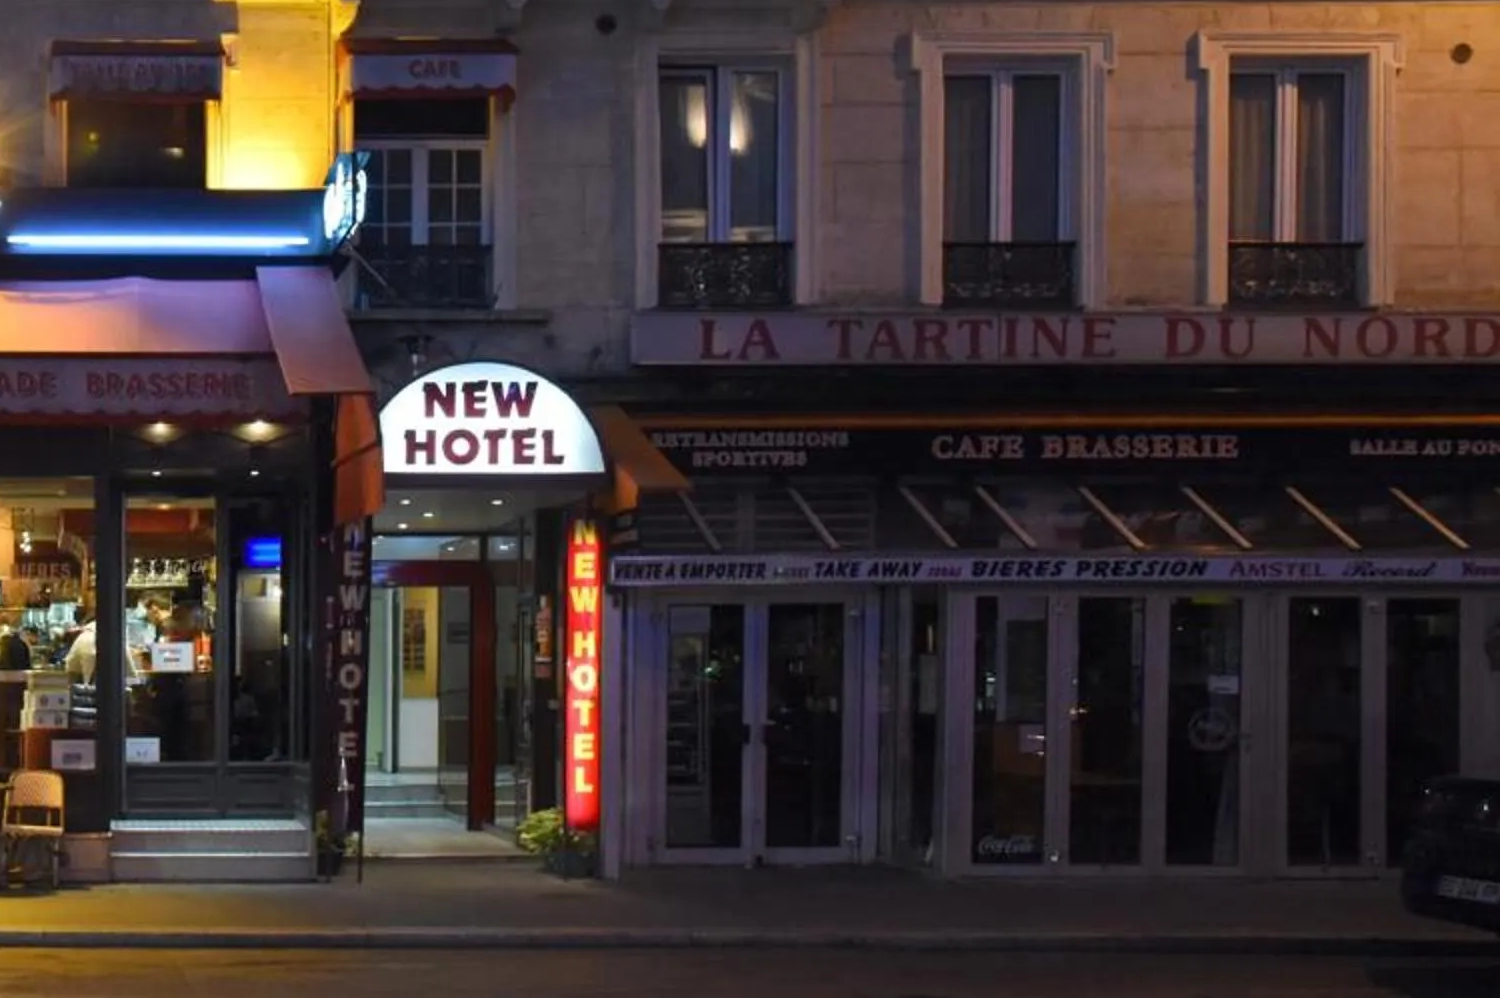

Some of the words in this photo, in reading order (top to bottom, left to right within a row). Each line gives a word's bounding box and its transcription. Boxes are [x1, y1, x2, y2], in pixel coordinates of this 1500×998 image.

[699, 318, 781, 360] LA
[825, 316, 1117, 361] TARTINE
[1162, 316, 1257, 359] DU
[1302, 316, 1500, 358] NORD
[86, 371, 253, 400] BRASSERIE
[422, 379, 538, 418] NEW
[403, 427, 565, 465] HOTEL
[652, 431, 850, 448] RETRANSMISSIONS
[932, 433, 1024, 461] CAFE
[1041, 433, 1240, 460] BRASSERIE
[1349, 438, 1418, 456] SALLE
[1424, 438, 1453, 456] AU
[693, 450, 808, 468] SPORTIVES
[569, 518, 598, 614] NEW
[615, 563, 662, 579] VENTE
[680, 562, 767, 579] EMPORTER
[815, 562, 862, 578] TAKE
[867, 562, 923, 578] AWAY
[971, 560, 1066, 579] BIERES
[1075, 559, 1208, 579] PRESSION
[1229, 559, 1326, 578] AMSTEL
[568, 631, 598, 794] HOTEL
